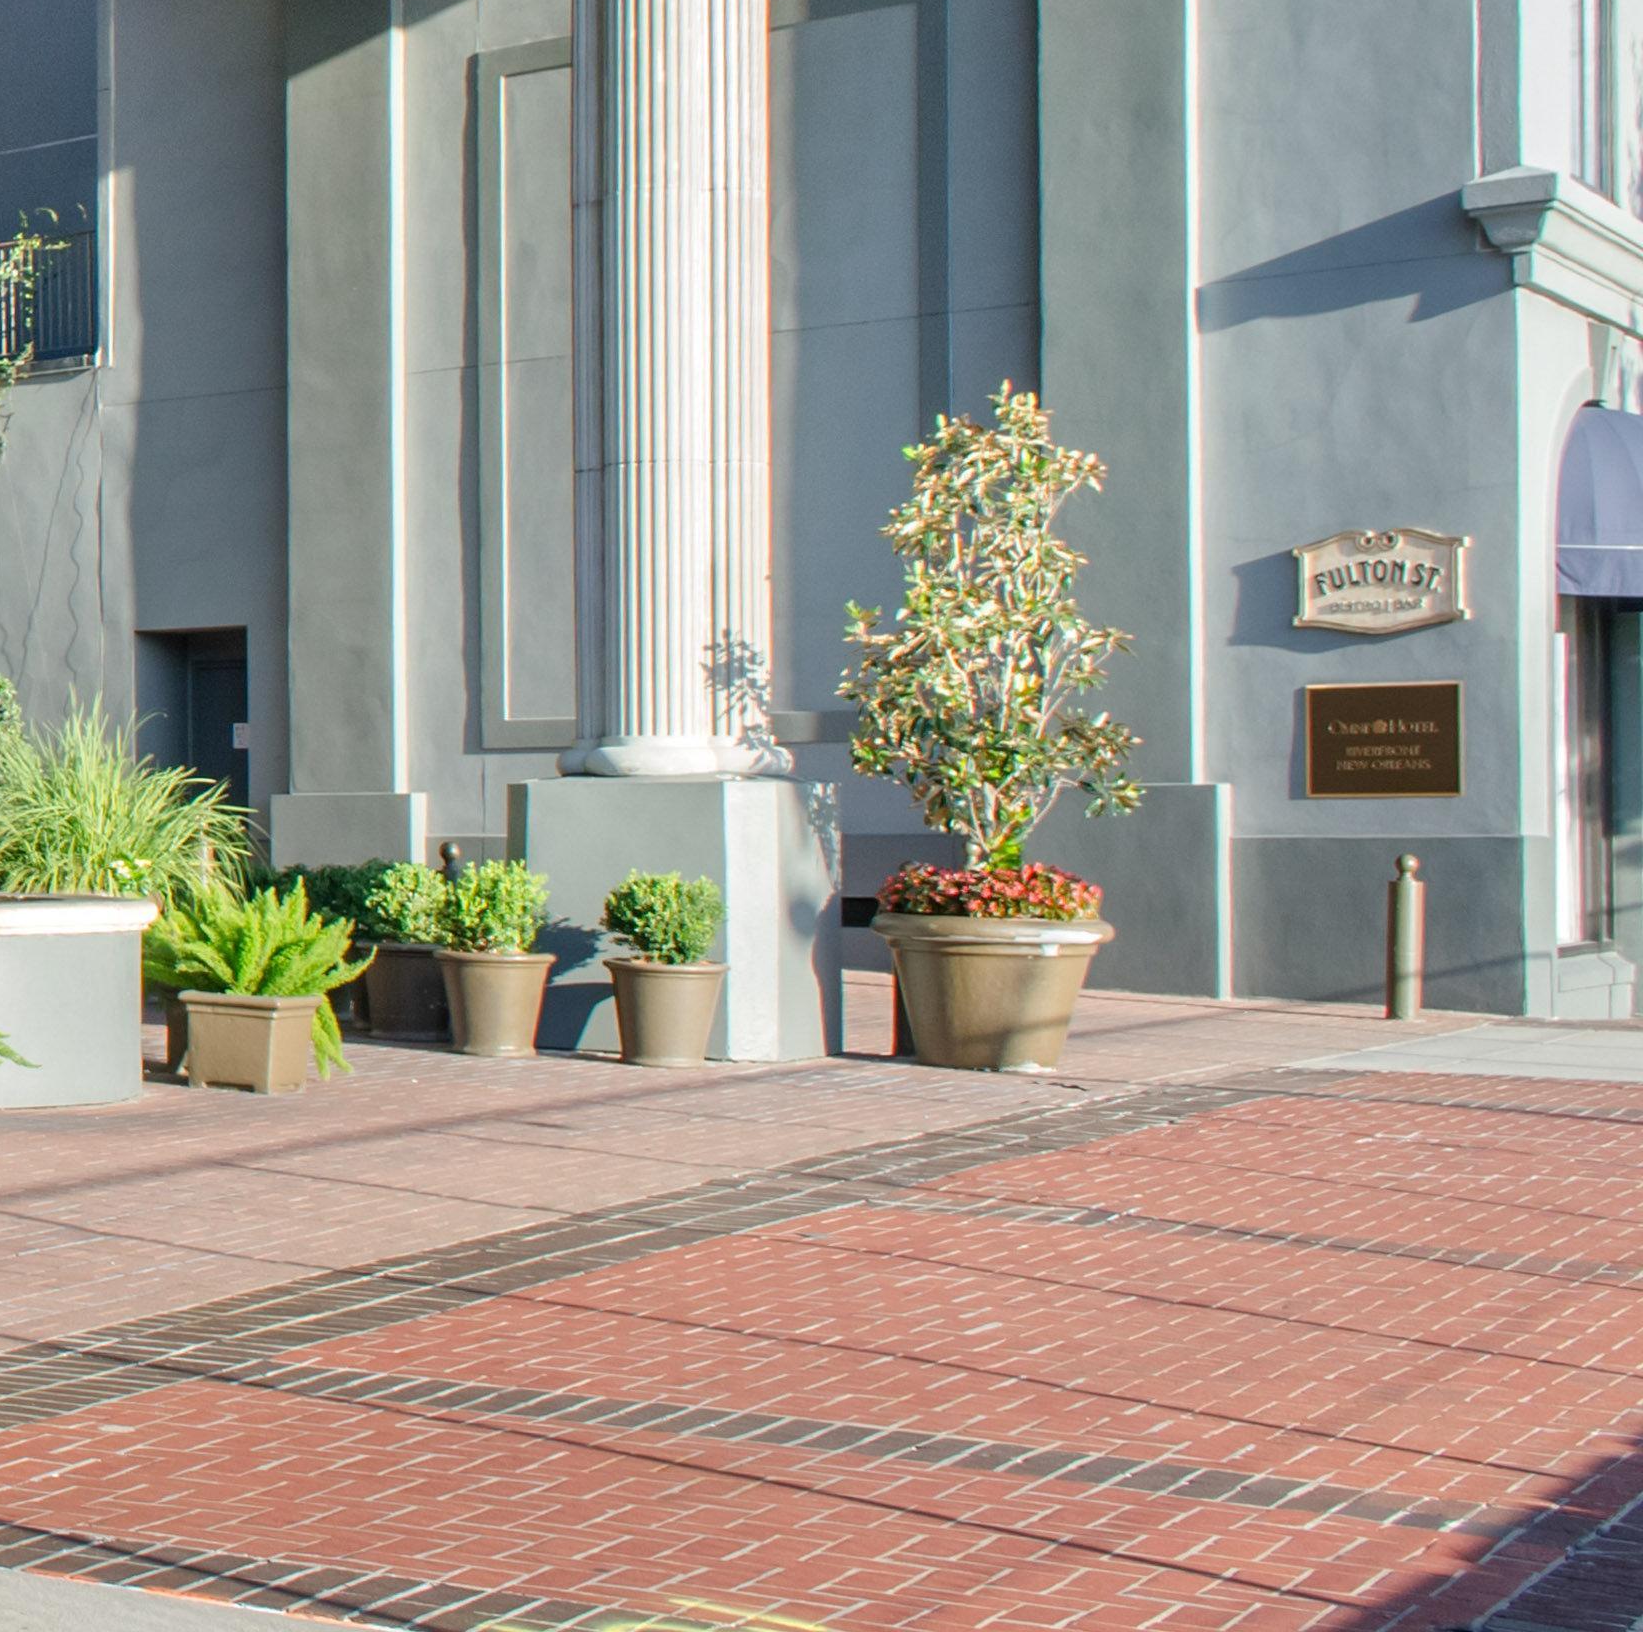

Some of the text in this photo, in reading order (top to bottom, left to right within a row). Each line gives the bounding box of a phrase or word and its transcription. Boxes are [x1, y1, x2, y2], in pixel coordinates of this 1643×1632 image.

[1314, 559, 1442, 596] FULTON ST.
[1388, 719, 1440, 734] HOTEL
[1336, 758, 1433, 771] NEW ORLEANS
